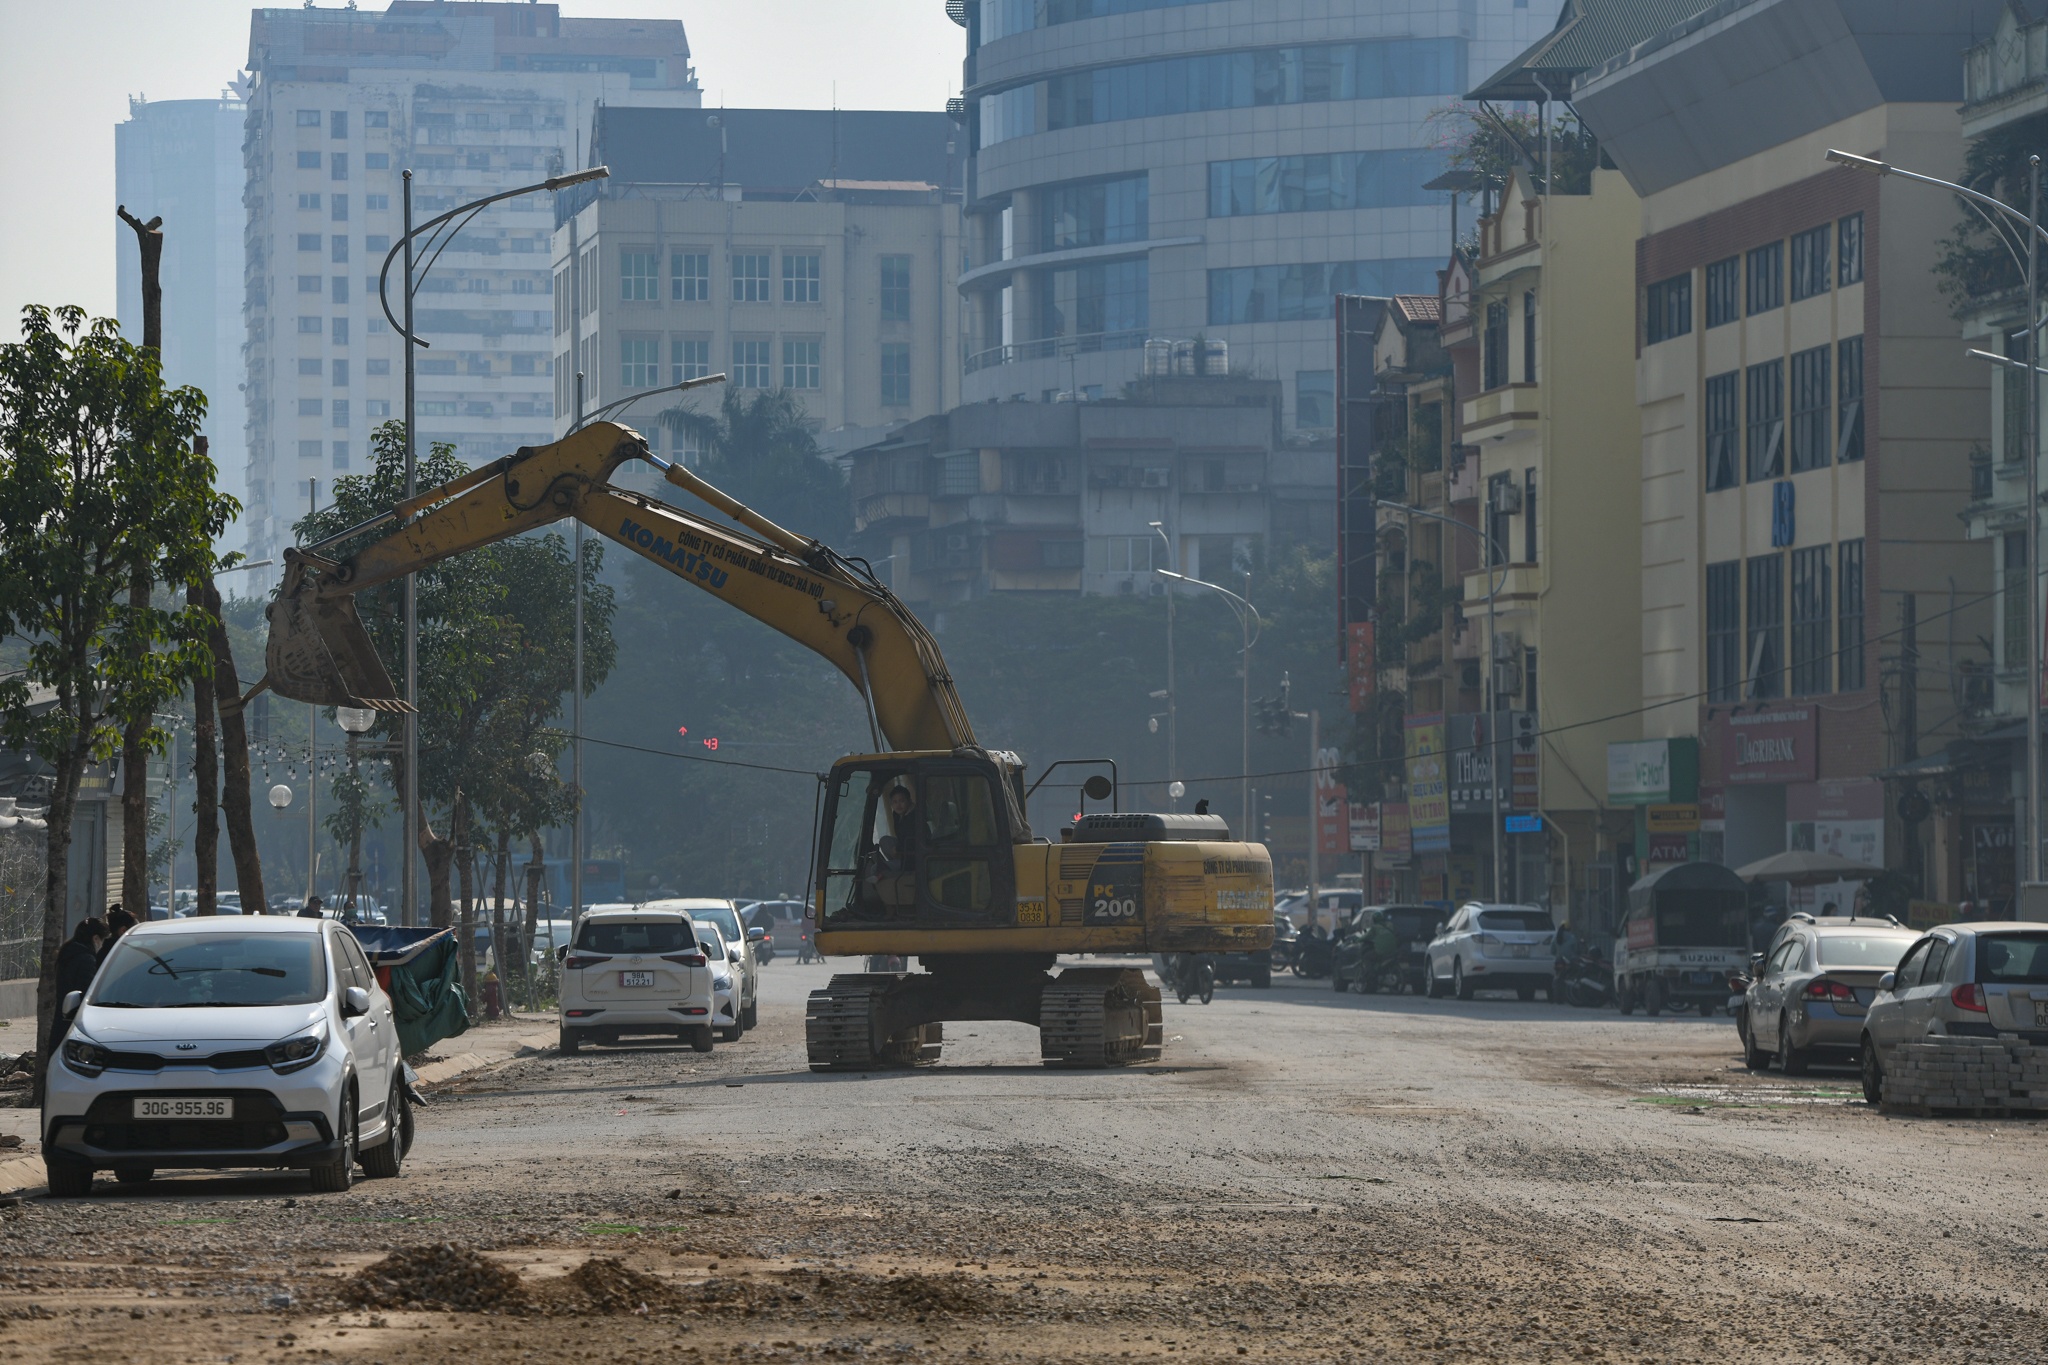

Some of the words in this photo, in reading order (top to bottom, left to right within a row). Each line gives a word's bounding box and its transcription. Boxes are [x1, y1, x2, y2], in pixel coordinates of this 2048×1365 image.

[1772, 481, 1795, 547] A3
[618, 517, 729, 589] KOMATSU
[678, 531, 702, 550] CÔNG
[702, 540, 713, 554] TY
[713, 542, 727, 559] CỔ
[795, 577, 808, 593] HÀ
[808, 582, 825, 600] NỘI
[703, 737, 719, 751] 43
[1747, 737, 1795, 764] AGRIBANK
[1456, 752, 1472, 783] TH
[1651, 846, 1687, 860] ATM
[1093, 884, 1114, 897] PC
[1019, 902, 1042, 912] 35-XA
[1094, 899, 1136, 917] 200
[1679, 954, 1726, 962] SUZUKI
[142, 1101, 225, 1116] 30G-955.96
